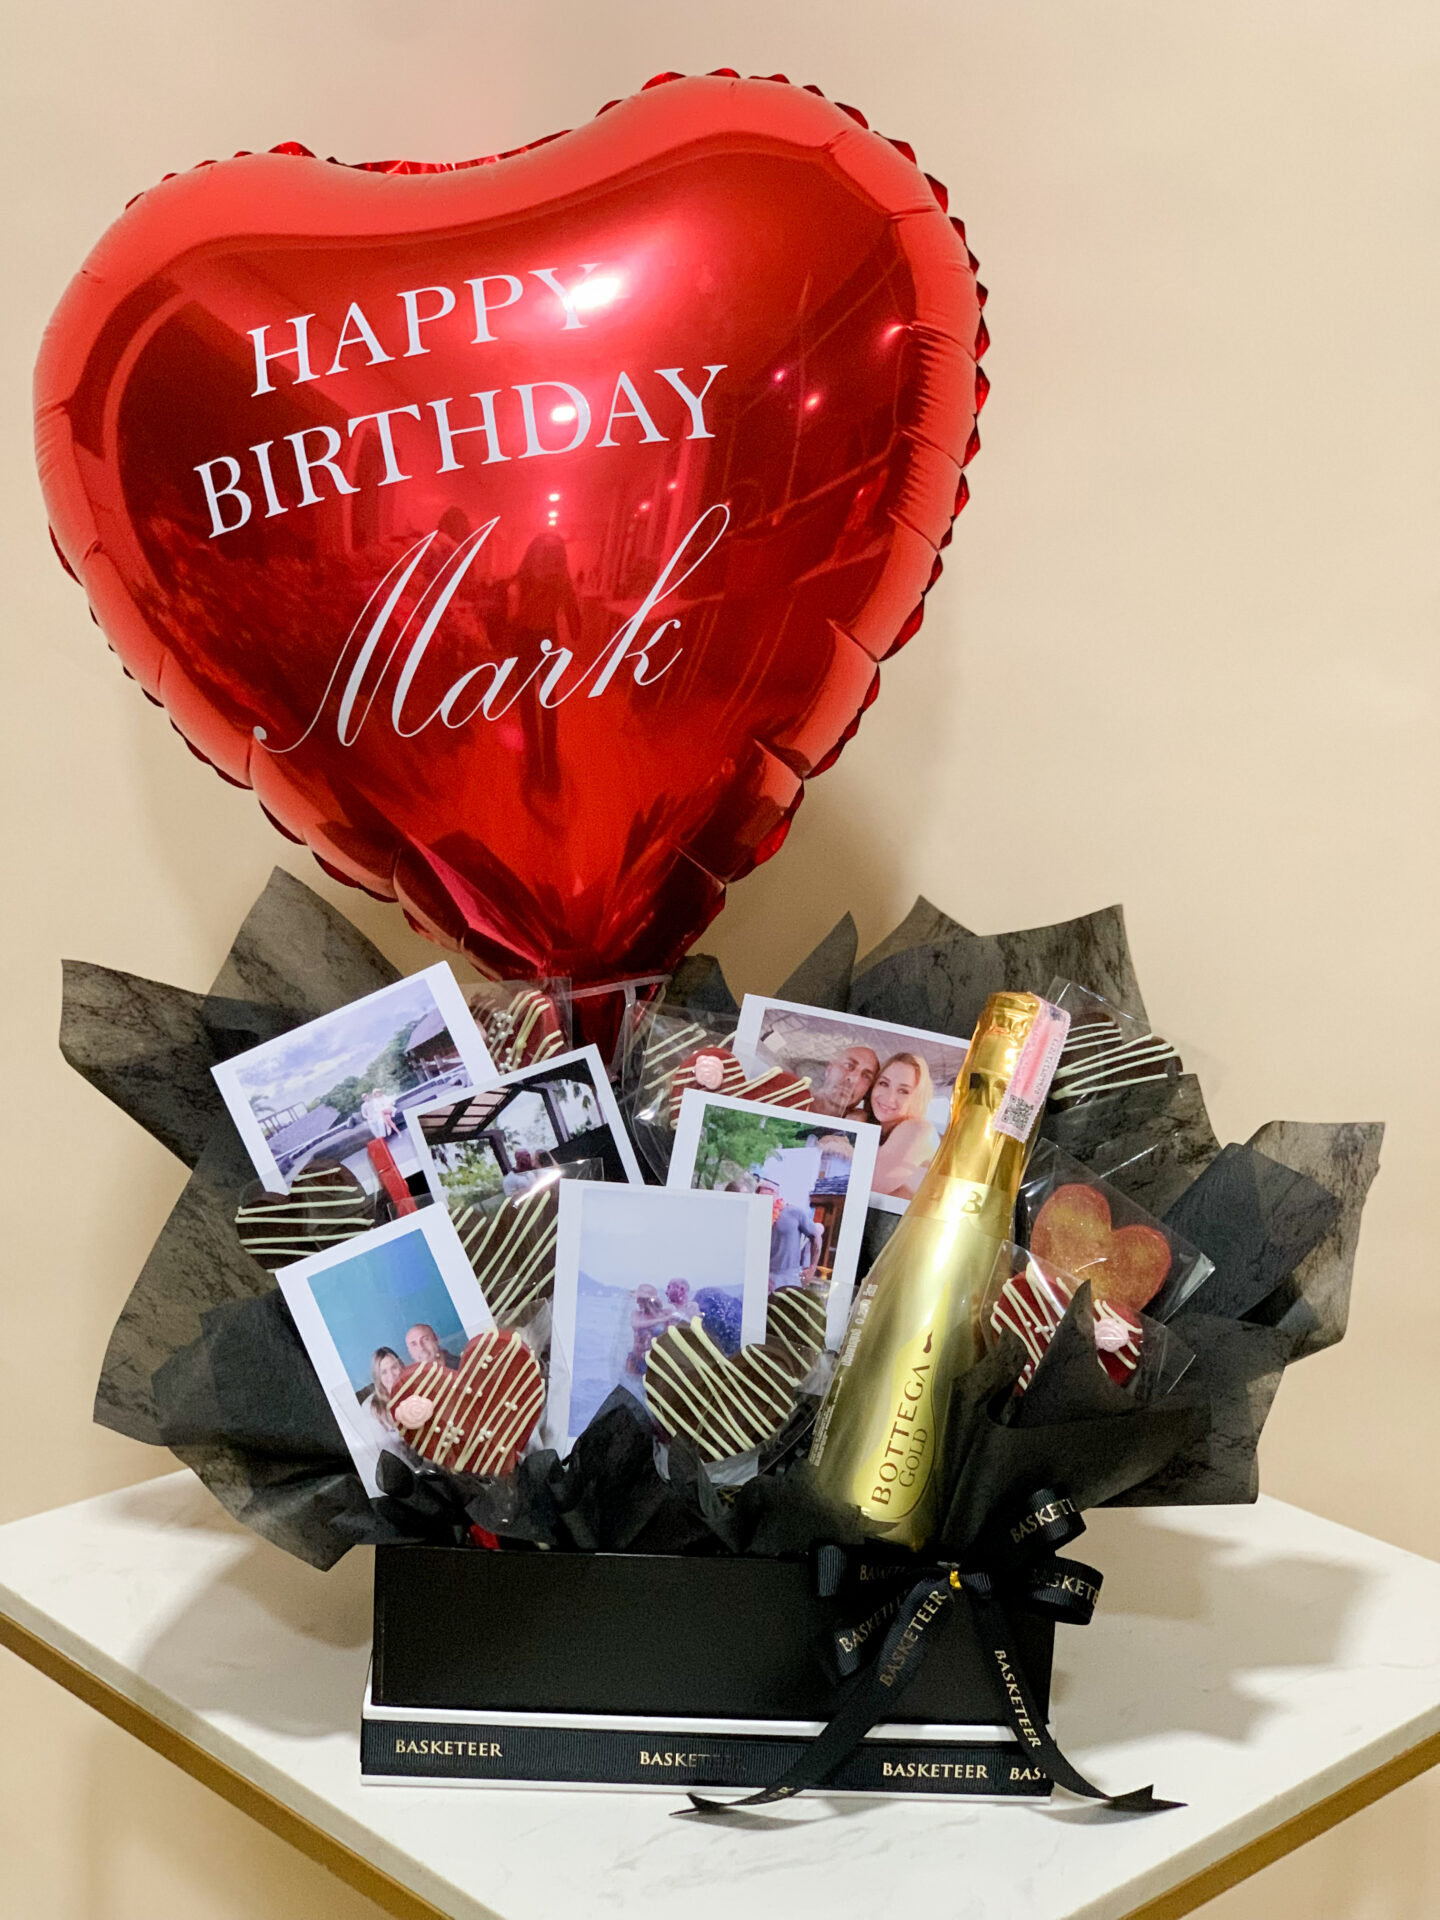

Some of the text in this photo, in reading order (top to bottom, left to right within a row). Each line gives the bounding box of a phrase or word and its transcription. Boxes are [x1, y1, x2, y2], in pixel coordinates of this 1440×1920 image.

[247, 263, 602, 398] HAPPY
[194, 365, 728, 539] BIRTHDAY
[253, 504, 730, 753] Mark
[871, 1365, 930, 1505] BOTTEGA
[898, 1427, 928, 1488] GOLD
[879, 1590, 948, 1687] BASKETEER
[994, 1649, 1042, 1748] BASKETEER
[395, 1738, 503, 1758] BASKETEER
[882, 1762, 989, 1780] BASKETEER
[1009, 1766, 1047, 1781] BAS
